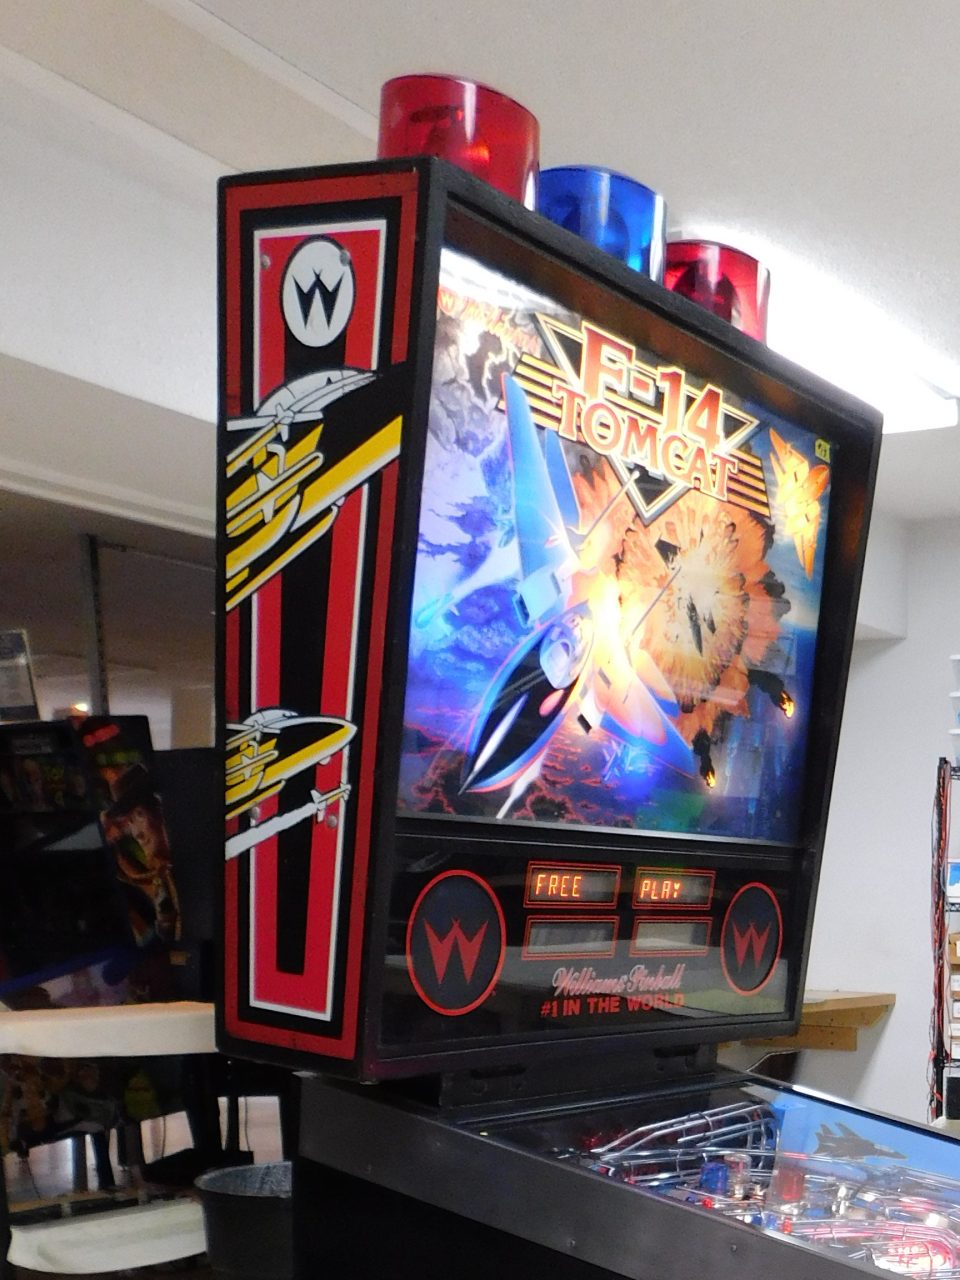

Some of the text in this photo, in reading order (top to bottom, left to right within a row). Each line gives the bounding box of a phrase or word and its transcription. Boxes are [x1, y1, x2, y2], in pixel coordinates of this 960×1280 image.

[292, 267, 345, 329] W
[578, 323, 725, 448] F-14
[550, 381, 739, 500] TOMCAT
[535, 873, 582, 898] FREE
[640, 880, 682, 900] PLAY
[423, 918, 489, 984] W
[732, 923, 771, 973] W
[552, 963, 686, 996] Williams Pinball
[540, 992, 686, 1018] #1 IN THE WORLD
